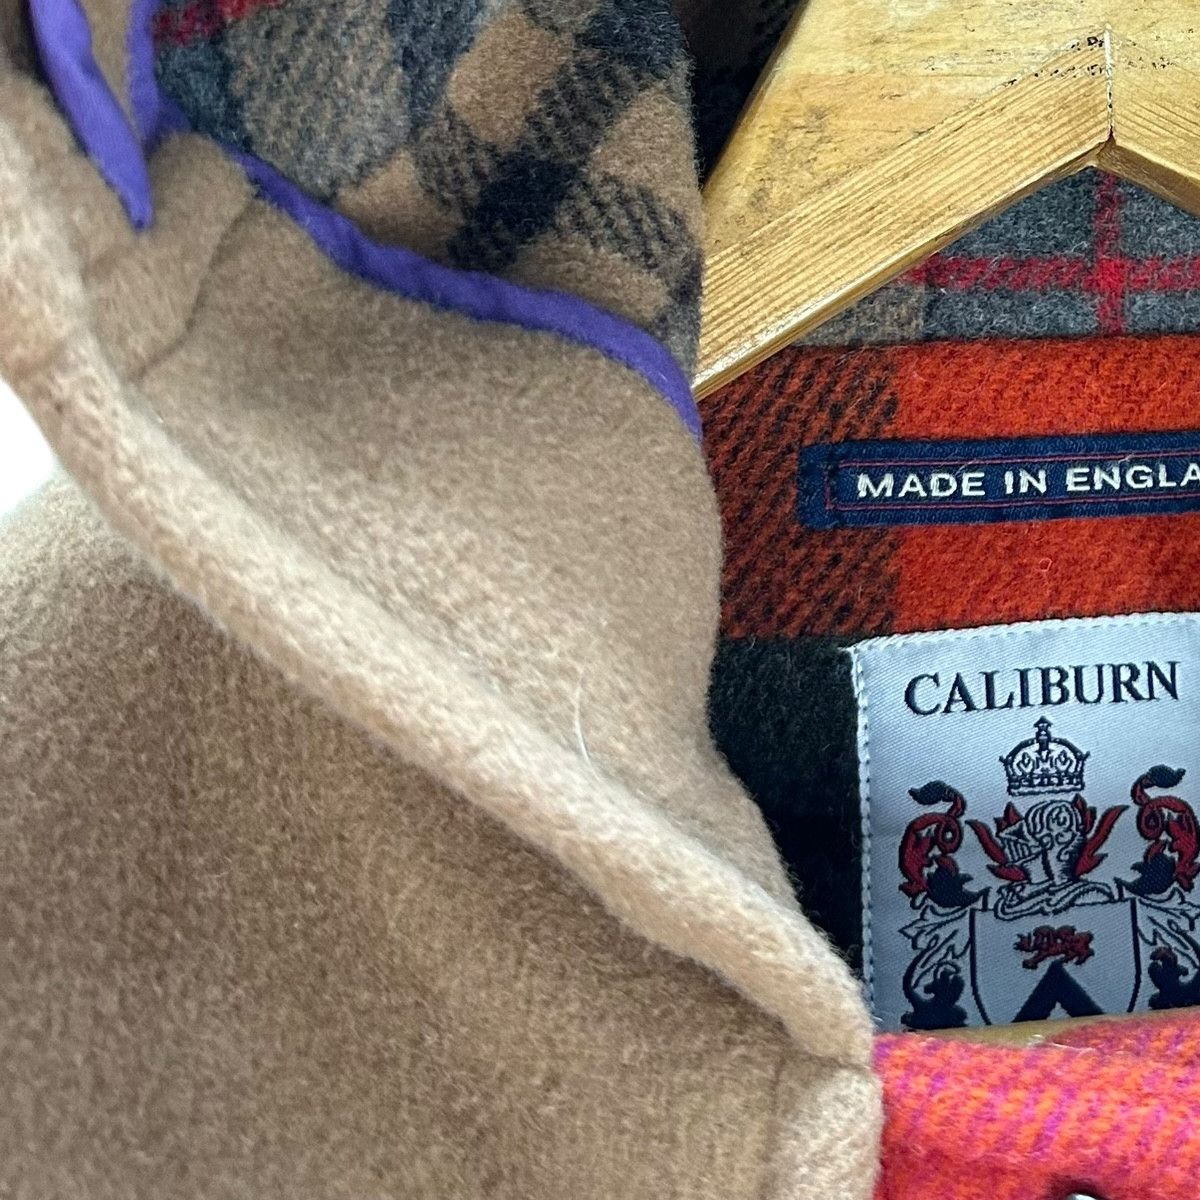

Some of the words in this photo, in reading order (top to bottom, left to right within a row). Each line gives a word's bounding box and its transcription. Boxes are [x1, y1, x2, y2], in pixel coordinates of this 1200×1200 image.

[857, 471, 986, 499] MADE
[1004, 469, 1047, 494] IN
[904, 661, 1182, 715] CALIBURN
